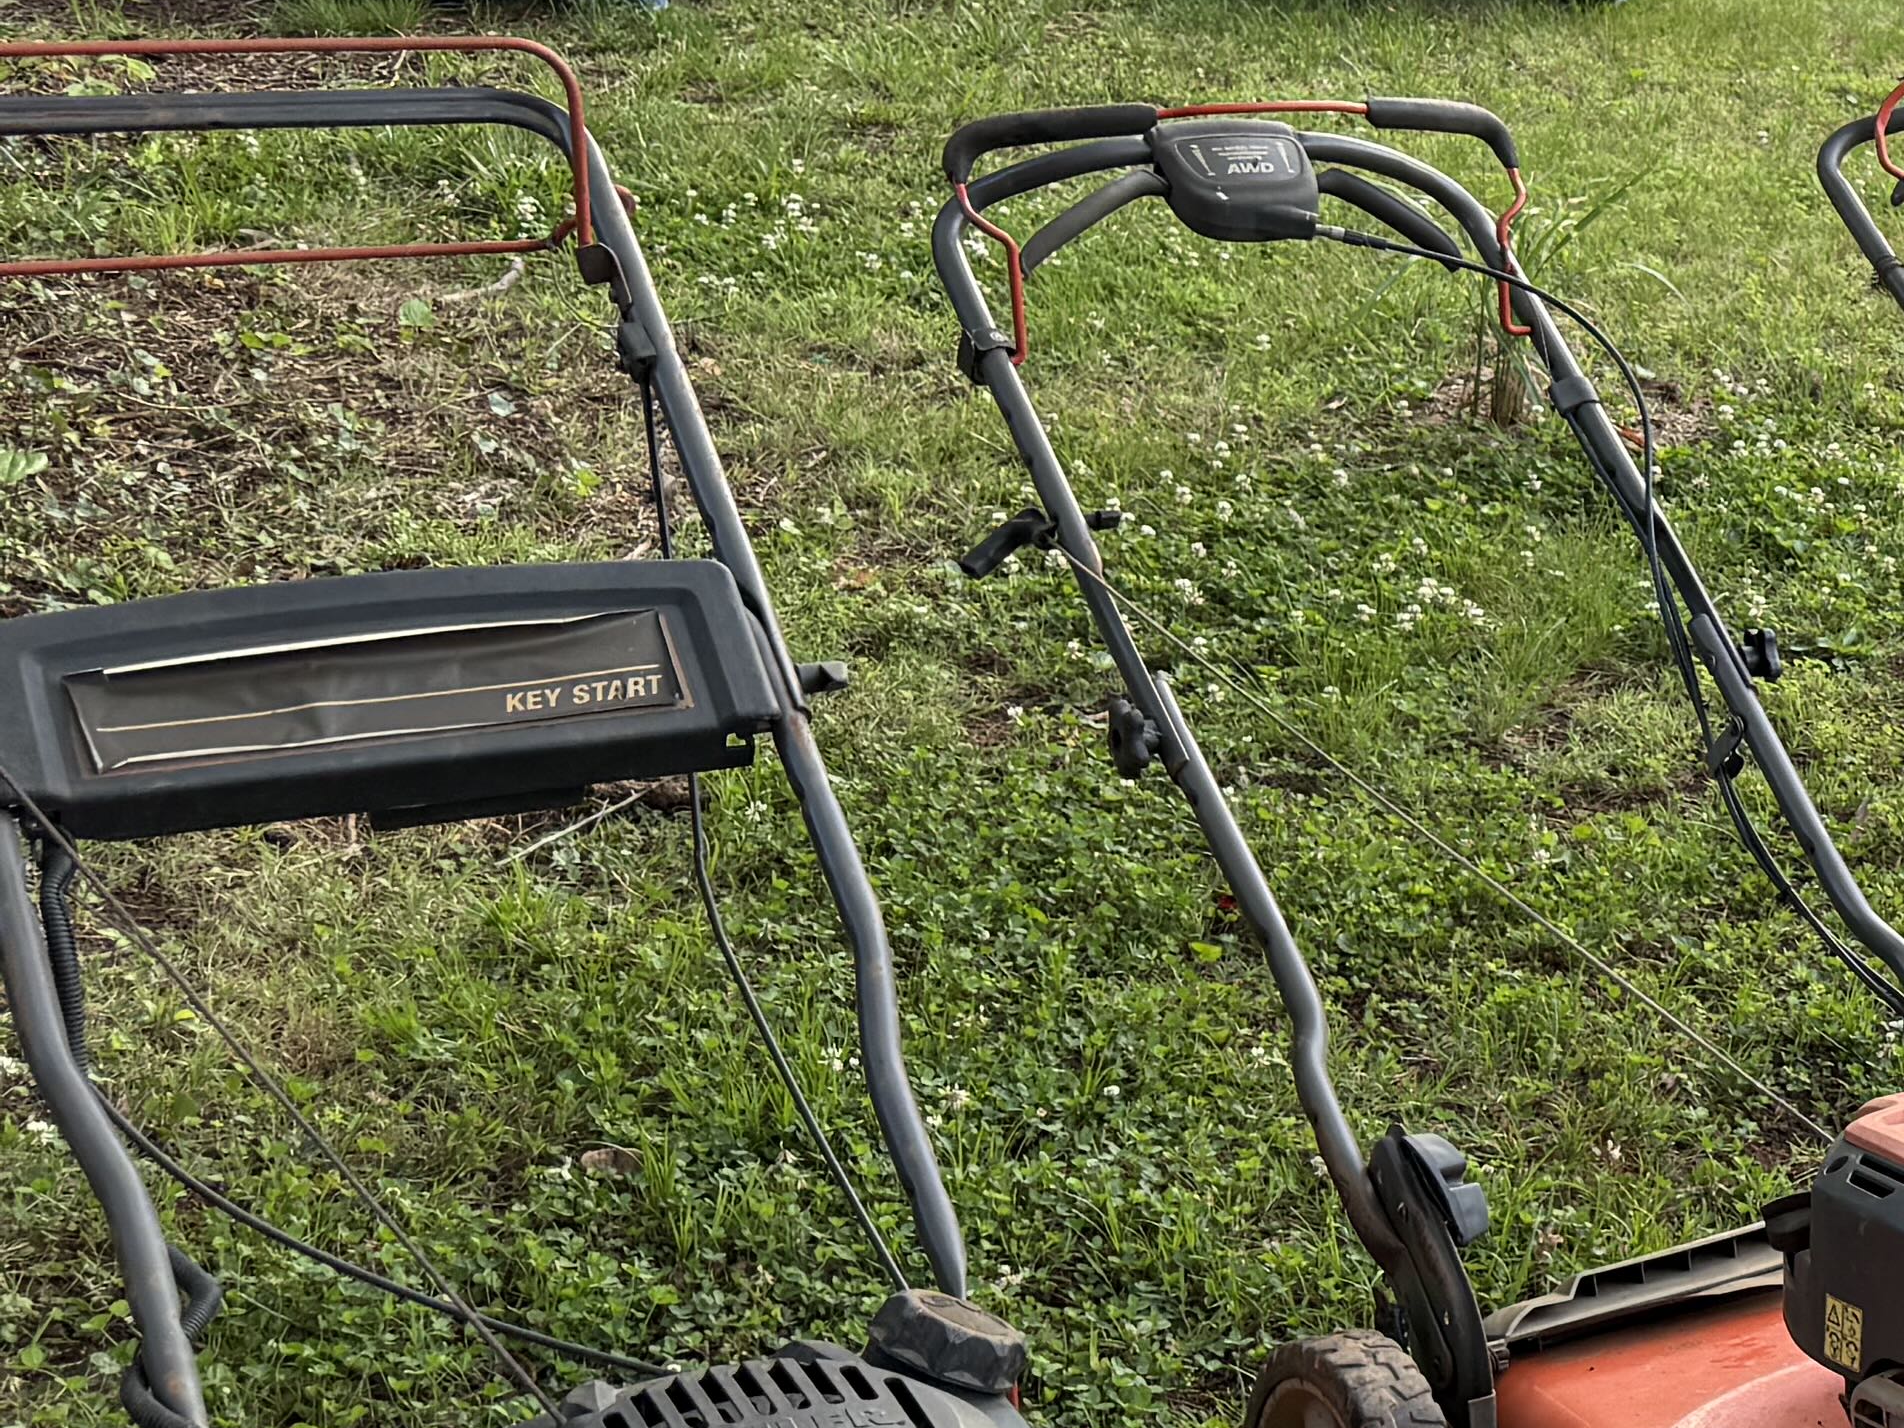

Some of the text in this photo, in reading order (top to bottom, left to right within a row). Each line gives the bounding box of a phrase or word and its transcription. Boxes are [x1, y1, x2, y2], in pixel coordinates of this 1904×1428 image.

[1227, 161, 1275, 175] AWD
[506, 674, 663, 713] KEY START
